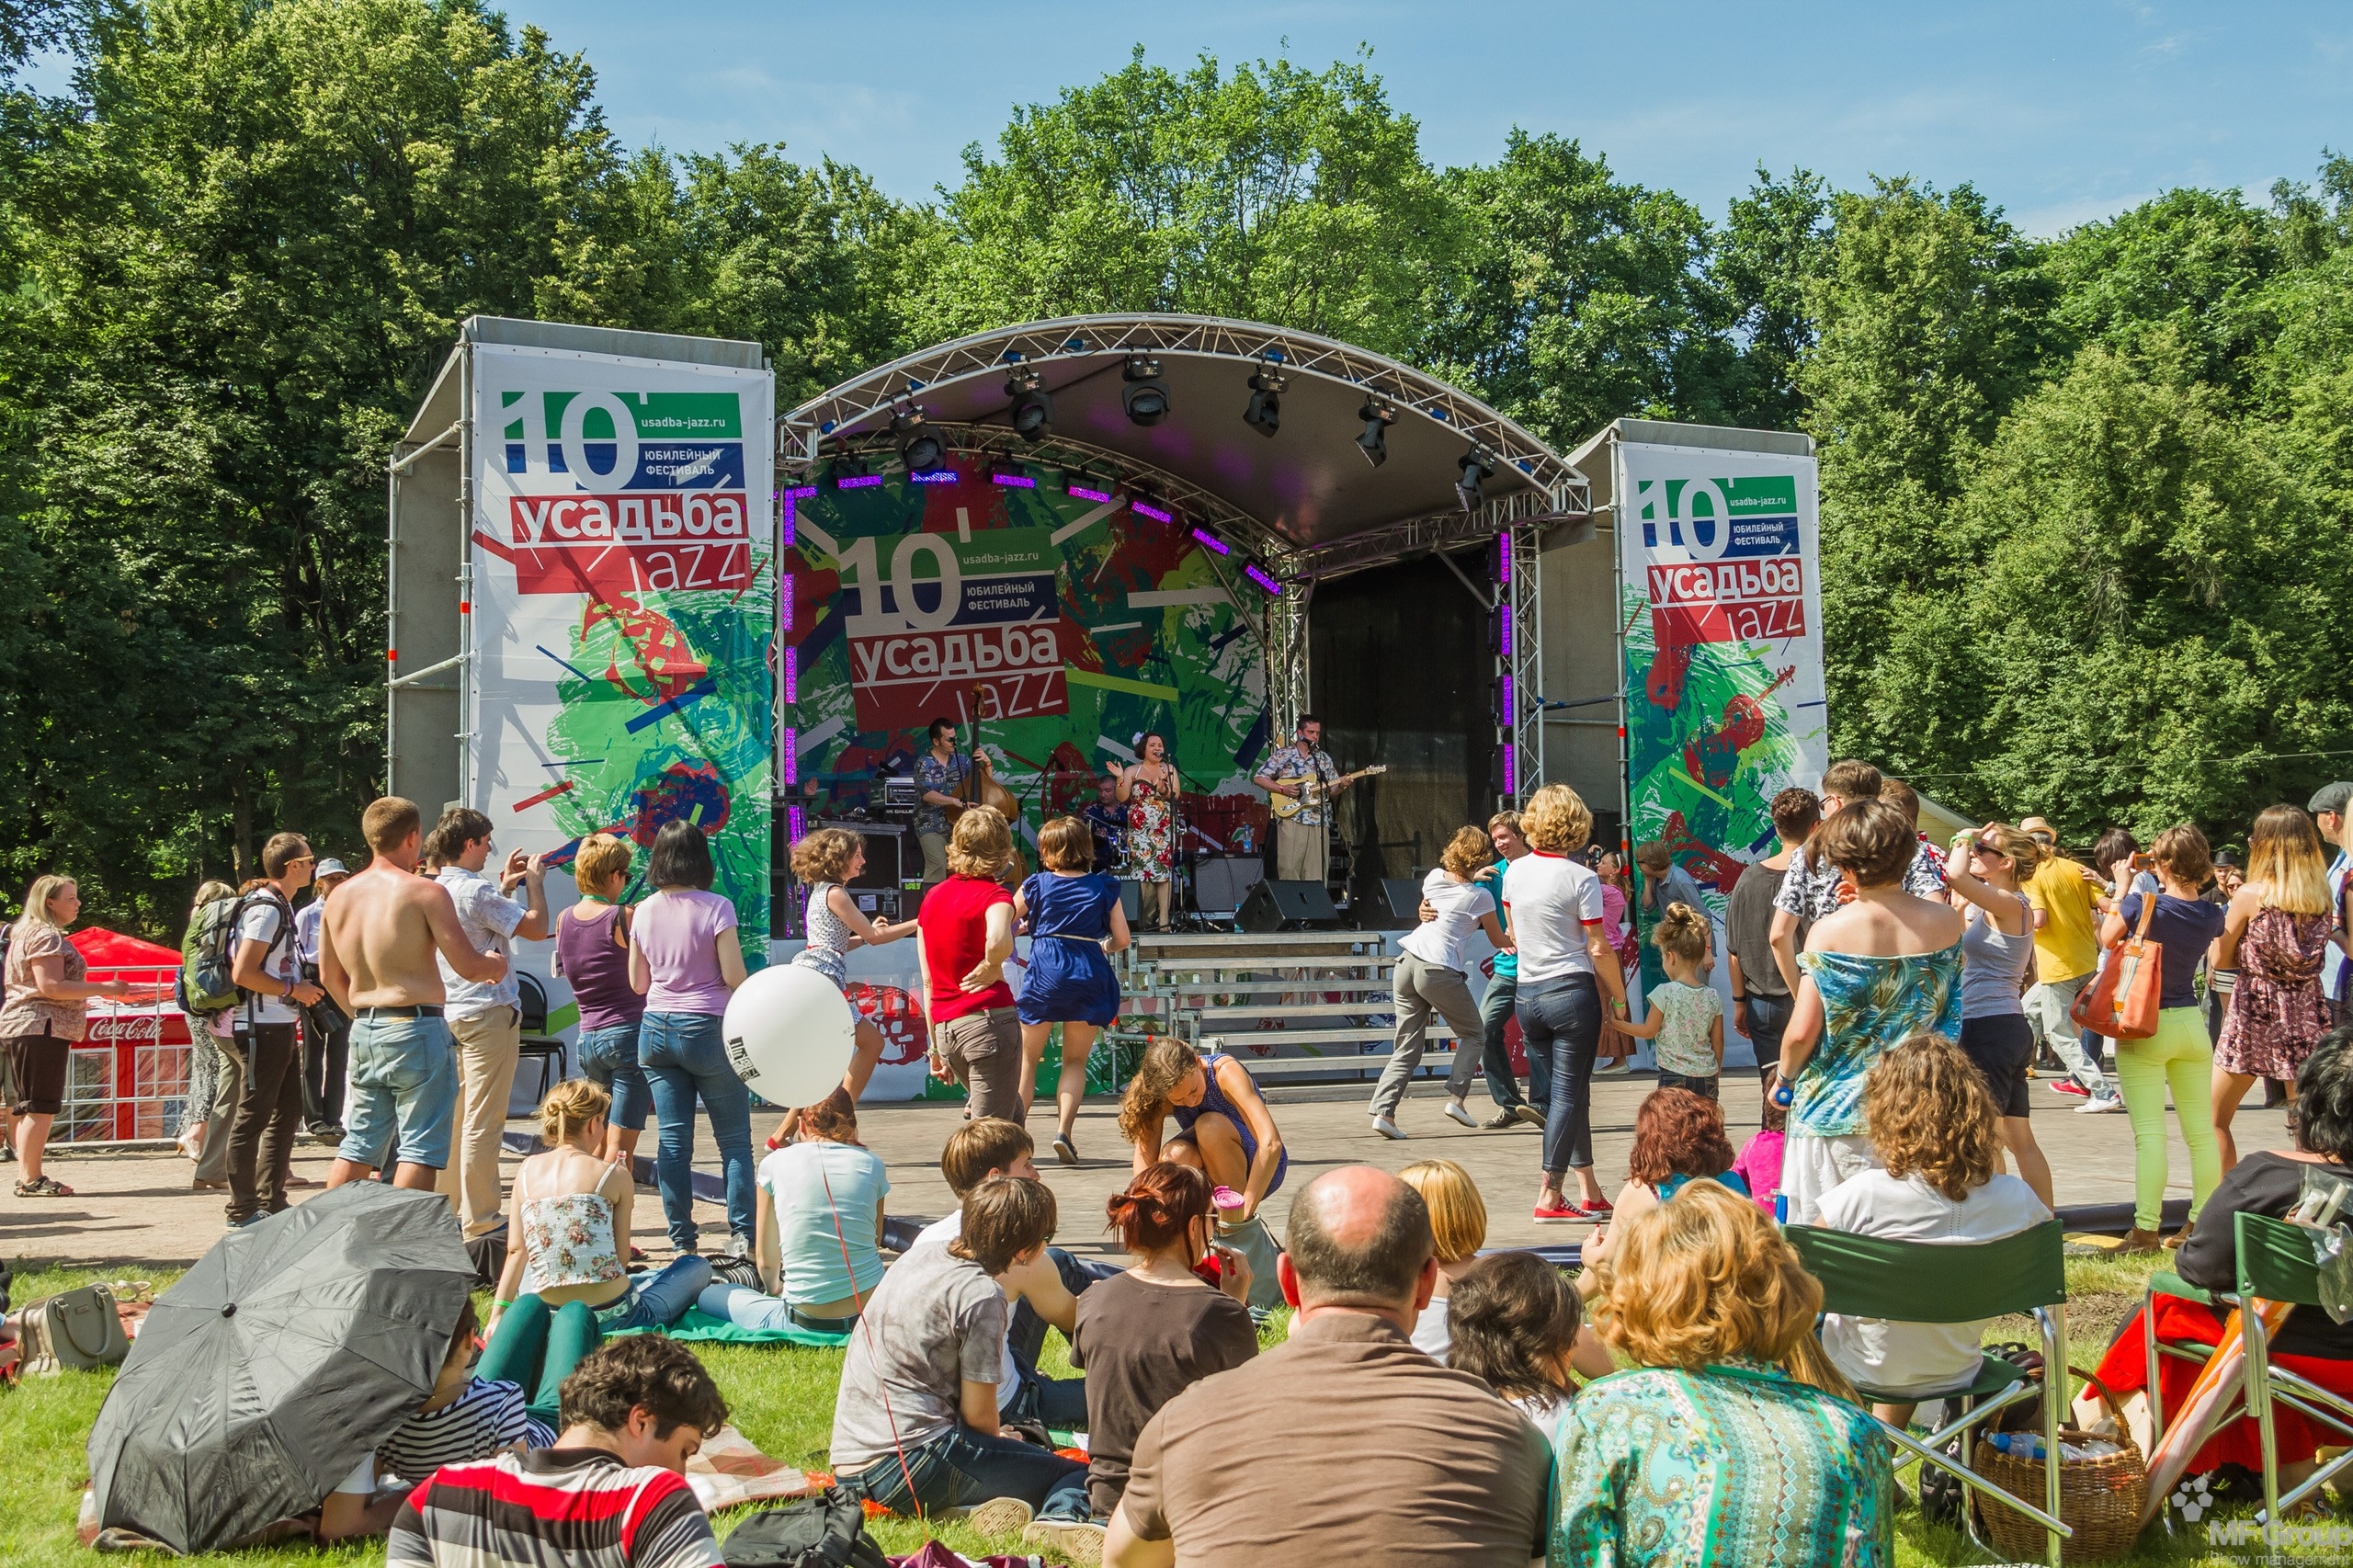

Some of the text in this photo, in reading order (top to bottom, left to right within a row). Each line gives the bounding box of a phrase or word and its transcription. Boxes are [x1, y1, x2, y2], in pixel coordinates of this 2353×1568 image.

[641, 416, 726, 429] usadba-jazz.ru
[502, 390, 640, 491] 10
[644, 448, 721, 460] ЮБИЛЕЙНЫЙ
[645, 464, 715, 475] ФЕСТИВАЛЬ
[516, 479, 743, 542] усадьба
[1730, 496, 1787, 507] usadba-jazz.ru
[1639, 477, 1730, 560] 10
[1733, 521, 1784, 534] ЮБИЛЕЙНЫЙ
[1734, 536, 1781, 546] ФЕСТИВАЛЬ
[962, 551, 1040, 565] usadba-jazz.ru
[628, 541, 746, 616] jazz
[838, 532, 962, 632] 10
[1651, 546, 1800, 605] усадьба
[966, 581, 1035, 597] ЮБИЛЕЙНЫЙ
[968, 597, 1030, 611] ФЕСТИВАЛЬ
[1727, 599, 1802, 661] jazz
[853, 610, 1059, 684] усадьба
[956, 672, 1063, 746] jazz
[89, 1017, 166, 1040] Coca-Cola
